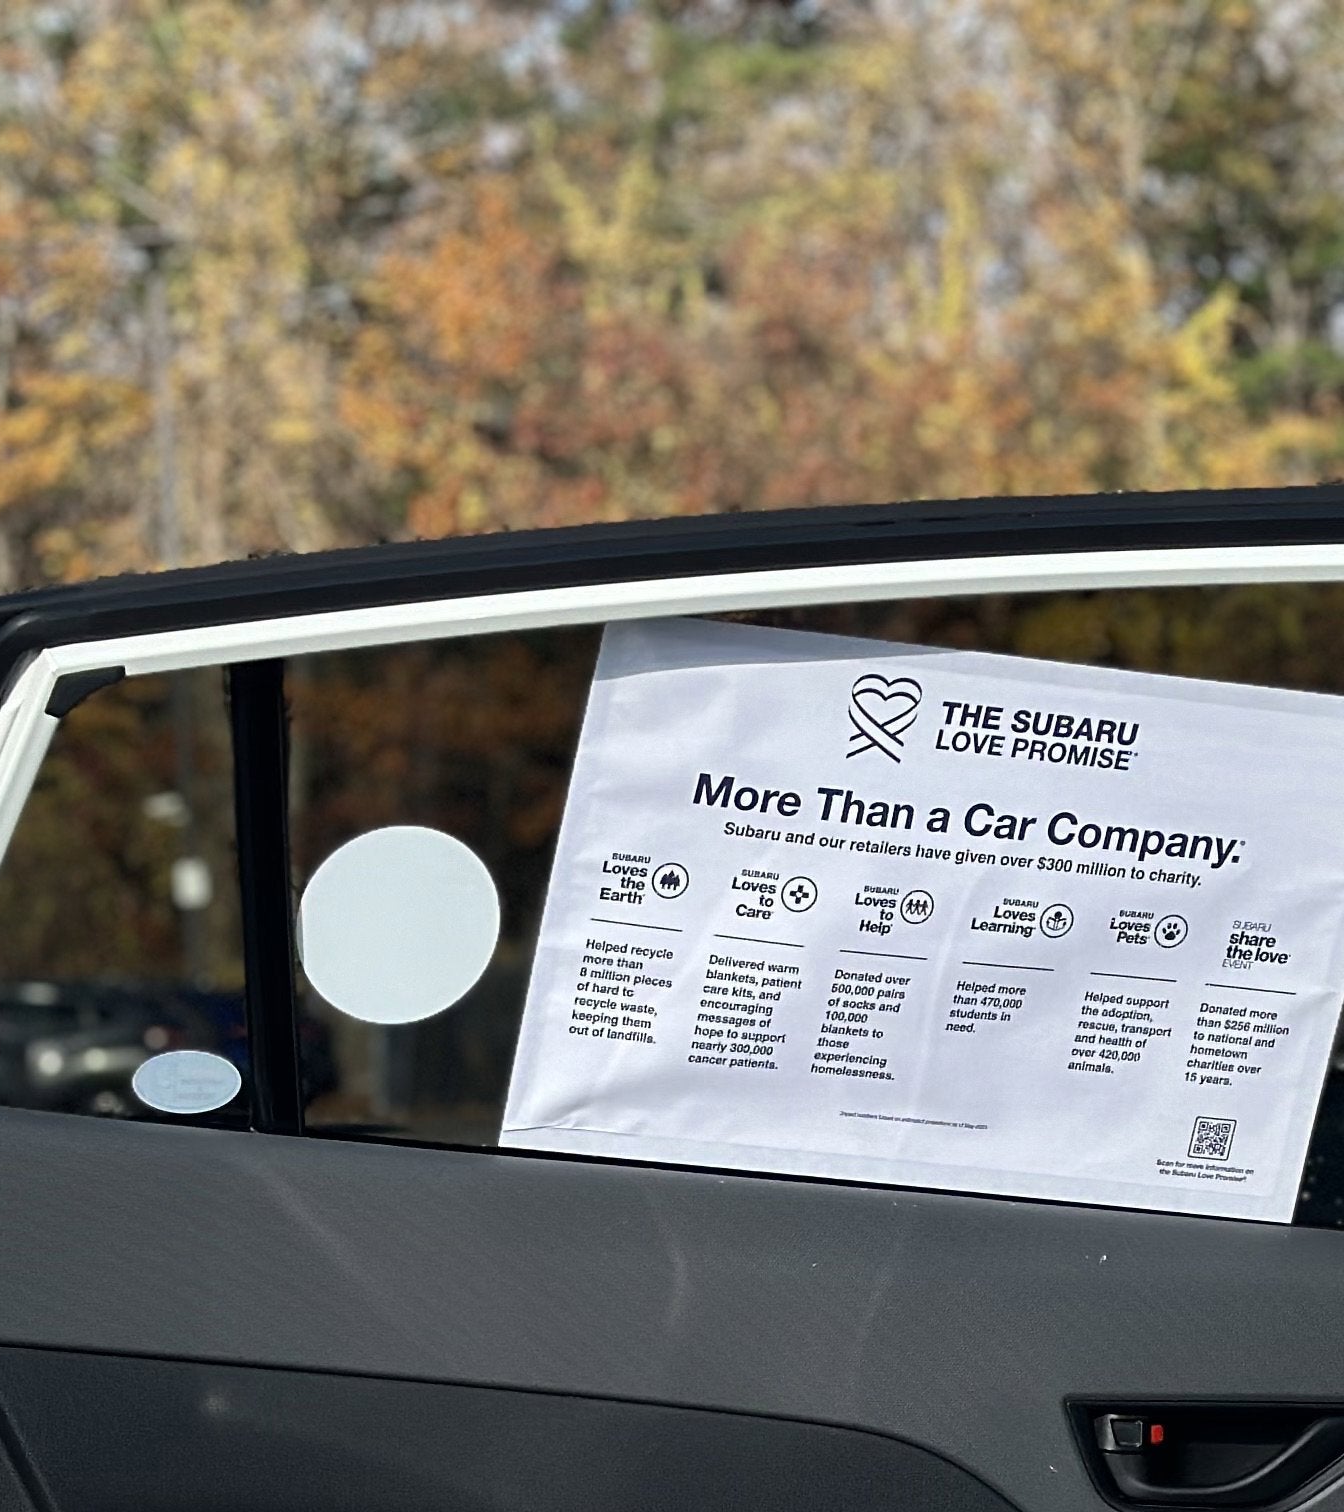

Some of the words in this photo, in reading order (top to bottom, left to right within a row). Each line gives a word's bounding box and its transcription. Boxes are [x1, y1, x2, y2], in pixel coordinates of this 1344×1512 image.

[941, 701, 1001, 732] THE
[1012, 709, 1140, 747] SUBARU
[935, 729, 1005, 756] LOVE
[693, 773, 801, 816] More
[817, 787, 914, 829] Than
[927, 808, 950, 833] a
[964, 803, 1037, 840] Car
[612, 852, 651, 864] SUBARU
[724, 822, 781, 841] Subaru
[785, 833, 815, 845] and
[819, 837, 846, 849] our
[850, 840, 911, 856] retailers
[915, 844, 951, 860] have
[955, 849, 995, 864] given
[1000, 856, 1034, 868] over
[1037, 857, 1072, 872] $300
[1076, 862, 1126, 878] million
[1131, 867, 1145, 879] to
[1149, 869, 1201, 888] charity.
[602, 860, 648, 878] Loves
[741, 868, 780, 881] SUBARU
[620, 877, 645, 891] the
[731, 876, 777, 894] Loves
[864, 885, 899, 896] SUBARU
[759, 895, 774, 907] to
[855, 892, 897, 909] Loves
[1003, 898, 1039, 908] SUBARU
[879, 908, 893, 921] to
[994, 905, 1036, 922] Loves
[1119, 909, 1154, 920] SUBARU
[1110, 918, 1151, 933] Loves
[1232, 920, 1272, 933] SUBARU
[1229, 931, 1276, 948] share
[586, 939, 628, 953] Helped
[631, 947, 673, 959] recycle
[1226, 945, 1253, 961] the
[583, 955, 613, 966] more
[617, 958, 643, 969] than
[709, 954, 765, 970] Delivered
[768, 965, 799, 975] warm
[1222, 959, 1254, 970] EVENT
[580, 967, 587, 976] 8
[590, 969, 630, 982] million
[633, 975, 672, 988] pieces
[706, 969, 758, 986] blankets,
[761, 978, 802, 989] patient
[834, 969, 883, 983] Donated
[885, 976, 911, 985] over
[577, 982, 590, 991] of
[592, 983, 619, 995] hard
[623, 987, 634, 997] to
[703, 986, 728, 995] care
[732, 987, 755, 1000] kits,
[759, 991, 781, 1001] and
[831, 983, 875, 996] 500,000
[876, 989, 905, 999] pairs
[956, 981, 996, 994] Helped
[998, 986, 1026, 995] more
[575, 997, 616, 1009] recycle
[621, 1003, 657, 1016] waste,
[700, 999, 773, 1016] encouraging
[828, 997, 840, 1007] of
[842, 1000, 876, 1010] socks
[878, 1003, 901, 1013] and
[953, 993, 977, 1005] than
[980, 997, 1022, 1009] 470,000
[1084, 991, 1123, 1005] Helped
[1125, 997, 1169, 1009] support
[572, 1009, 618, 1027] keeping
[622, 1016, 651, 1028] them
[826, 1010, 868, 1023] 100,000
[949, 1009, 998, 1020] students
[1000, 1012, 1011, 1021] in
[1081, 1005, 1099, 1016] the
[1102, 1008, 1153, 1023] adoption,
[1200, 1003, 1247, 1017] Donated
[1249, 1010, 1277, 1020] more
[697, 1013, 756, 1027] messages
[759, 1018, 771, 1028] of
[945, 1023, 975, 1033] need.
[1197, 1017, 1221, 1028] than
[1224, 1020, 1251, 1031] $256
[1253, 1023, 1289, 1035] million
[569, 1026, 589, 1035] out
[592, 1027, 604, 1037] of
[607, 1028, 656, 1044] landfills.
[694, 1025, 723, 1039] hope
[727, 1029, 738, 1039] to
[741, 1032, 786, 1043] support
[821, 1023, 869, 1037] blankets
[872, 1029, 883, 1038] to
[1078, 1021, 1117, 1033] rescue,
[1121, 1023, 1171, 1037] transport
[816, 1037, 849, 1049] those
[1074, 1034, 1096, 1043] and
[1098, 1035, 1132, 1047] health
[1135, 1039, 1147, 1048] of
[1194, 1031, 1205, 1040] to
[1207, 1034, 1252, 1045] national
[1254, 1039, 1275, 1047] and
[691, 1041, 727, 1053] nearly
[729, 1043, 773, 1057] 300,000
[1071, 1048, 1096, 1057] over
[1099, 1049, 1140, 1062] 420,000
[1190, 1044, 1247, 1059] hometown
[688, 1055, 727, 1065] cancer
[729, 1058, 778, 1069] patients.
[814, 1052, 887, 1068] experiencing
[1067, 1061, 1114, 1074] animals.
[1187, 1058, 1234, 1072] charities
[1237, 1065, 1262, 1074] over
[811, 1063, 894, 1080] homelessness.
[1185, 1072, 1197, 1081] 15
[1199, 1075, 1232, 1086] years.
